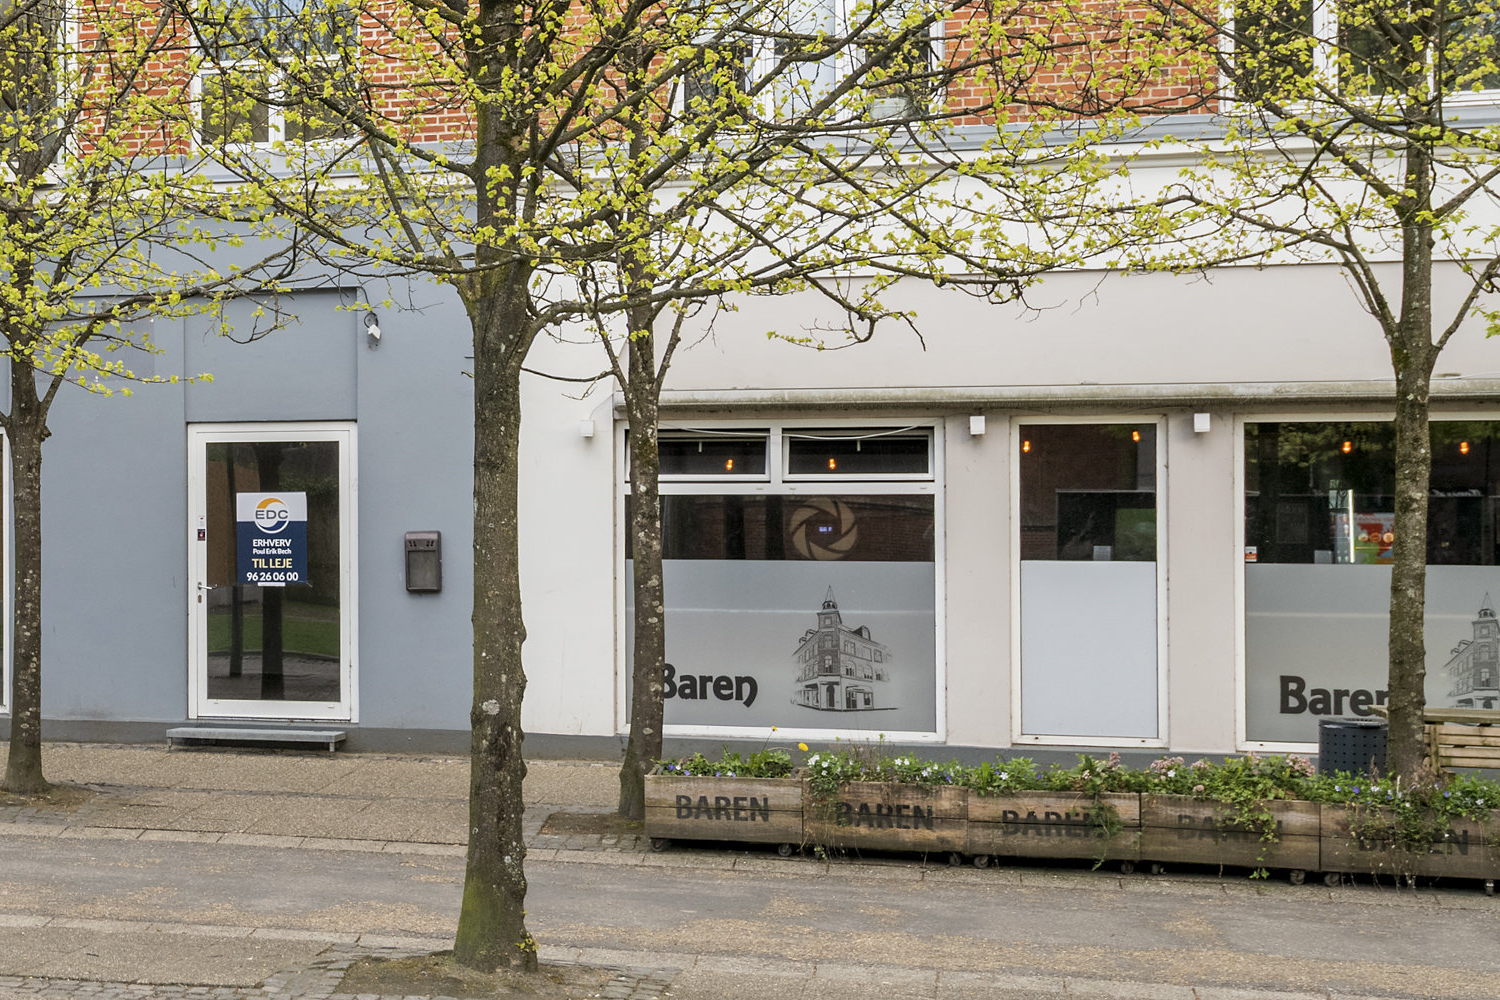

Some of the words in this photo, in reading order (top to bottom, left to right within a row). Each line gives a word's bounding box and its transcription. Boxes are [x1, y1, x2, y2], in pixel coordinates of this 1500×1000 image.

[255, 510, 288, 520] EDC
[252, 539, 292, 547] ERHVERV
[252, 558, 268, 569] TIL
[269, 558, 293, 569] LEJE
[246, 572, 258, 581] 96
[260, 572, 272, 581] 26
[273, 572, 285, 581] 06
[286, 572, 299, 581] 00
[675, 794, 770, 822] BAREN
